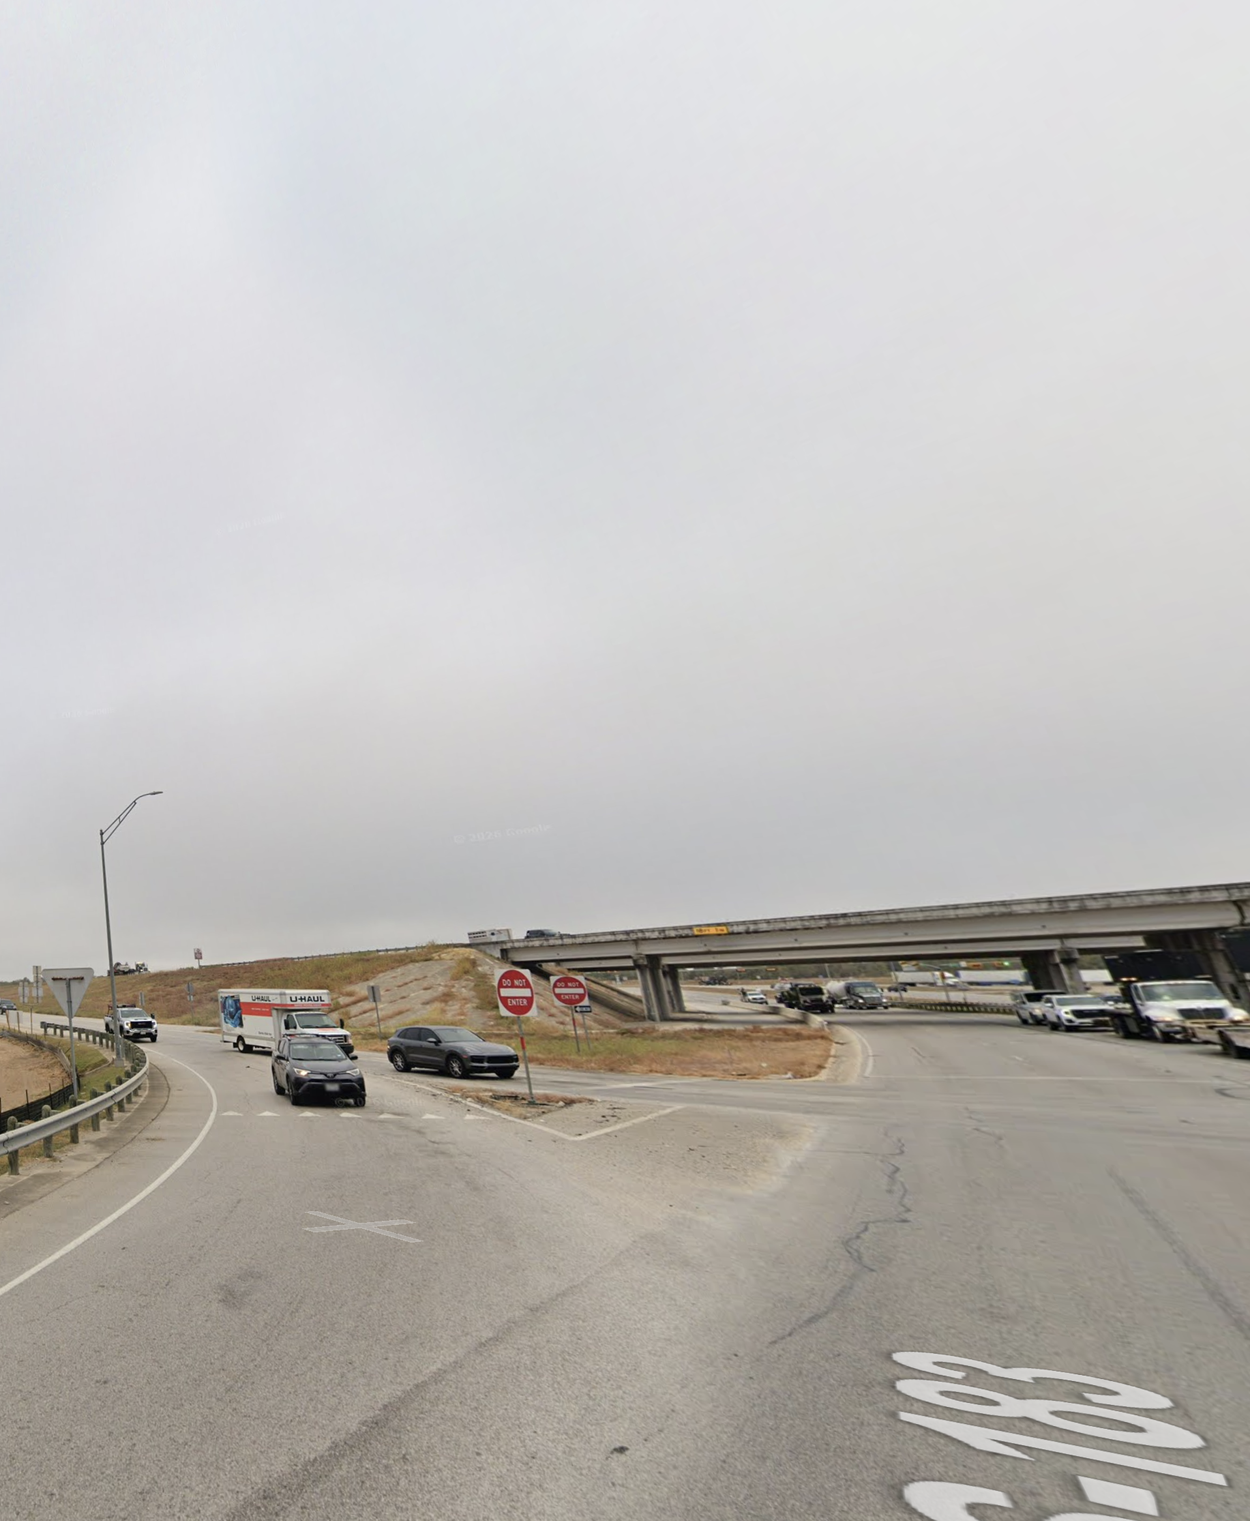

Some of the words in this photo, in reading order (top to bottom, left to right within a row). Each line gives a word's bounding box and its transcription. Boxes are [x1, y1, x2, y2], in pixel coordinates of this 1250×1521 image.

[502, 978, 512, 987] DO
[514, 978, 526, 987] NOT
[289, 995, 325, 1003] U-HAUL
[507, 998, 528, 1007] ENTER
